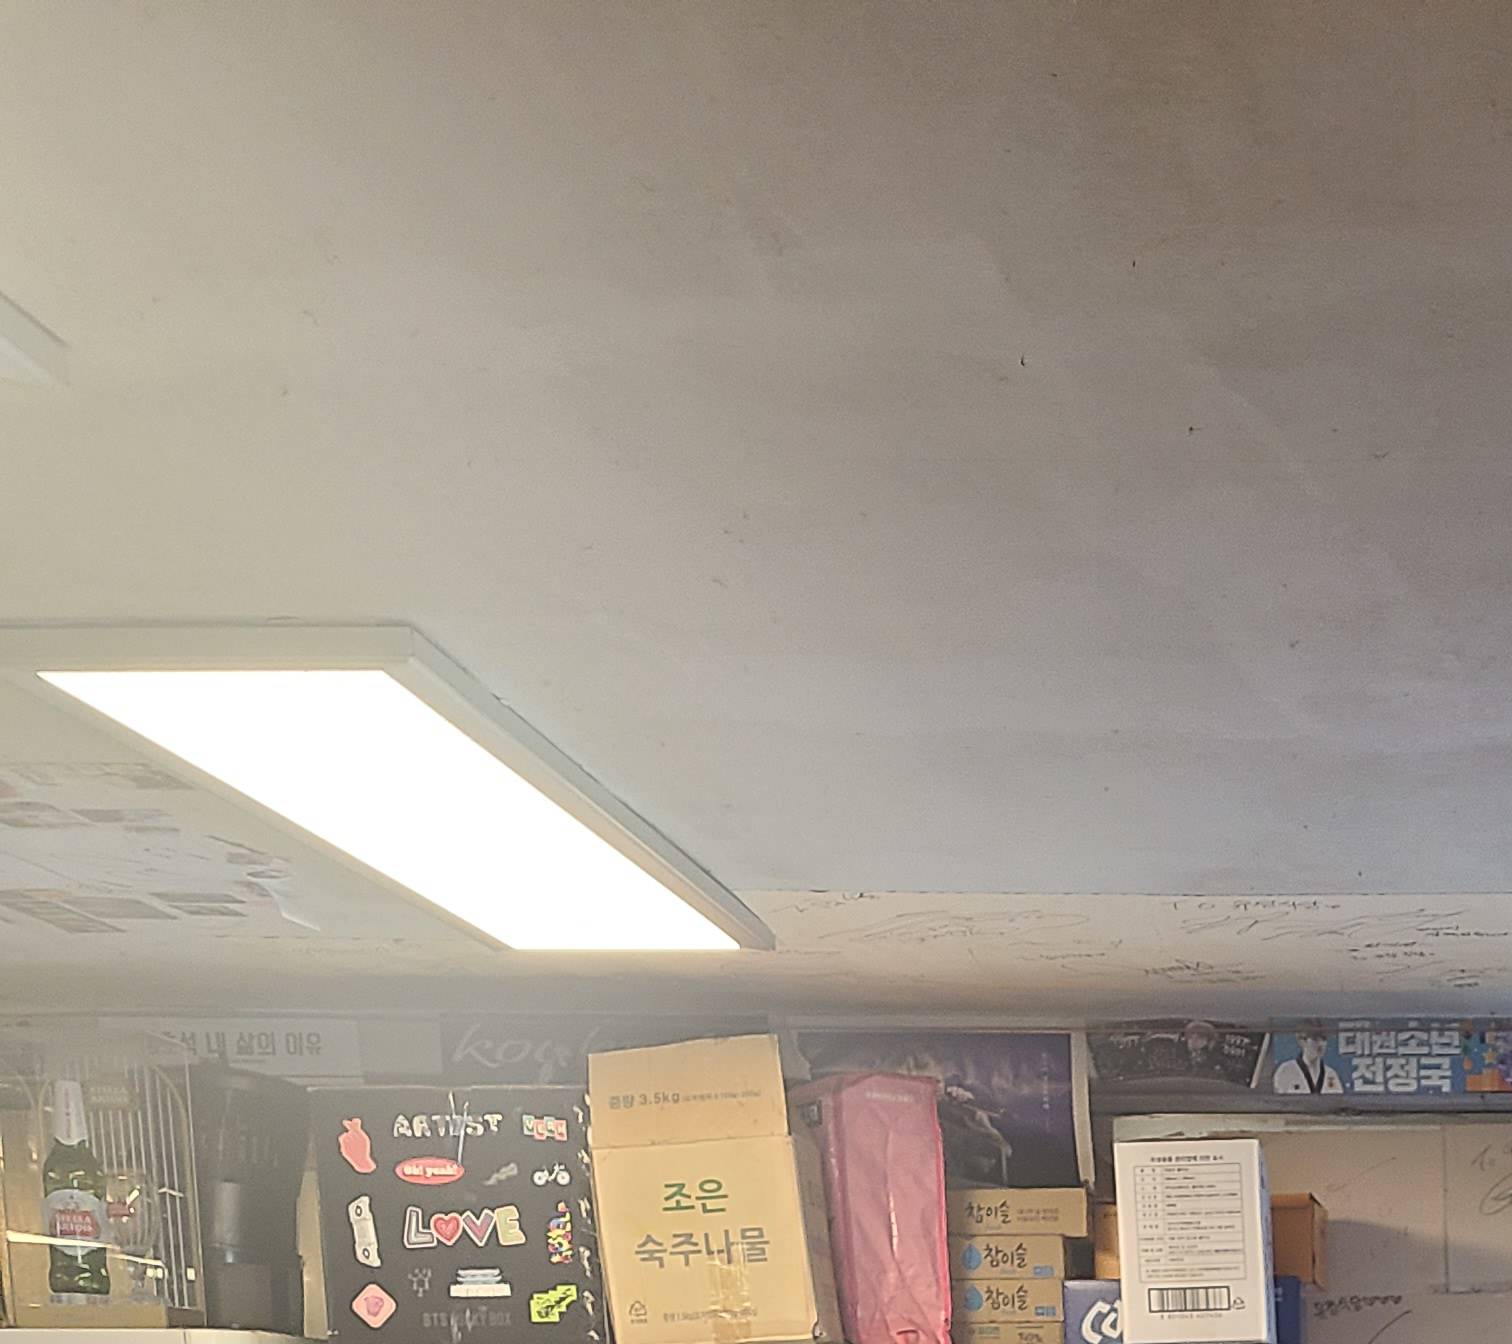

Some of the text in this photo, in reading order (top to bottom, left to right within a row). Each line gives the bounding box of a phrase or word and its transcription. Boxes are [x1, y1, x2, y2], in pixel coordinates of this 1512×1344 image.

[286, 1031, 321, 1055] 이유
[1352, 1057, 1451, 1092] 전정국
[639, 1091, 680, 1107] 3.5kg
[393, 1114, 502, 1137] ARTIST
[662, 1179, 728, 1213] 조은
[965, 1200, 1012, 1224] 참이슬
[635, 1227, 770, 1268] 숙주나물
[983, 1243, 1028, 1268] 참이슬
[985, 1284, 1028, 1311] 참이슬
[1081, 1300, 1121, 1344] Ca
